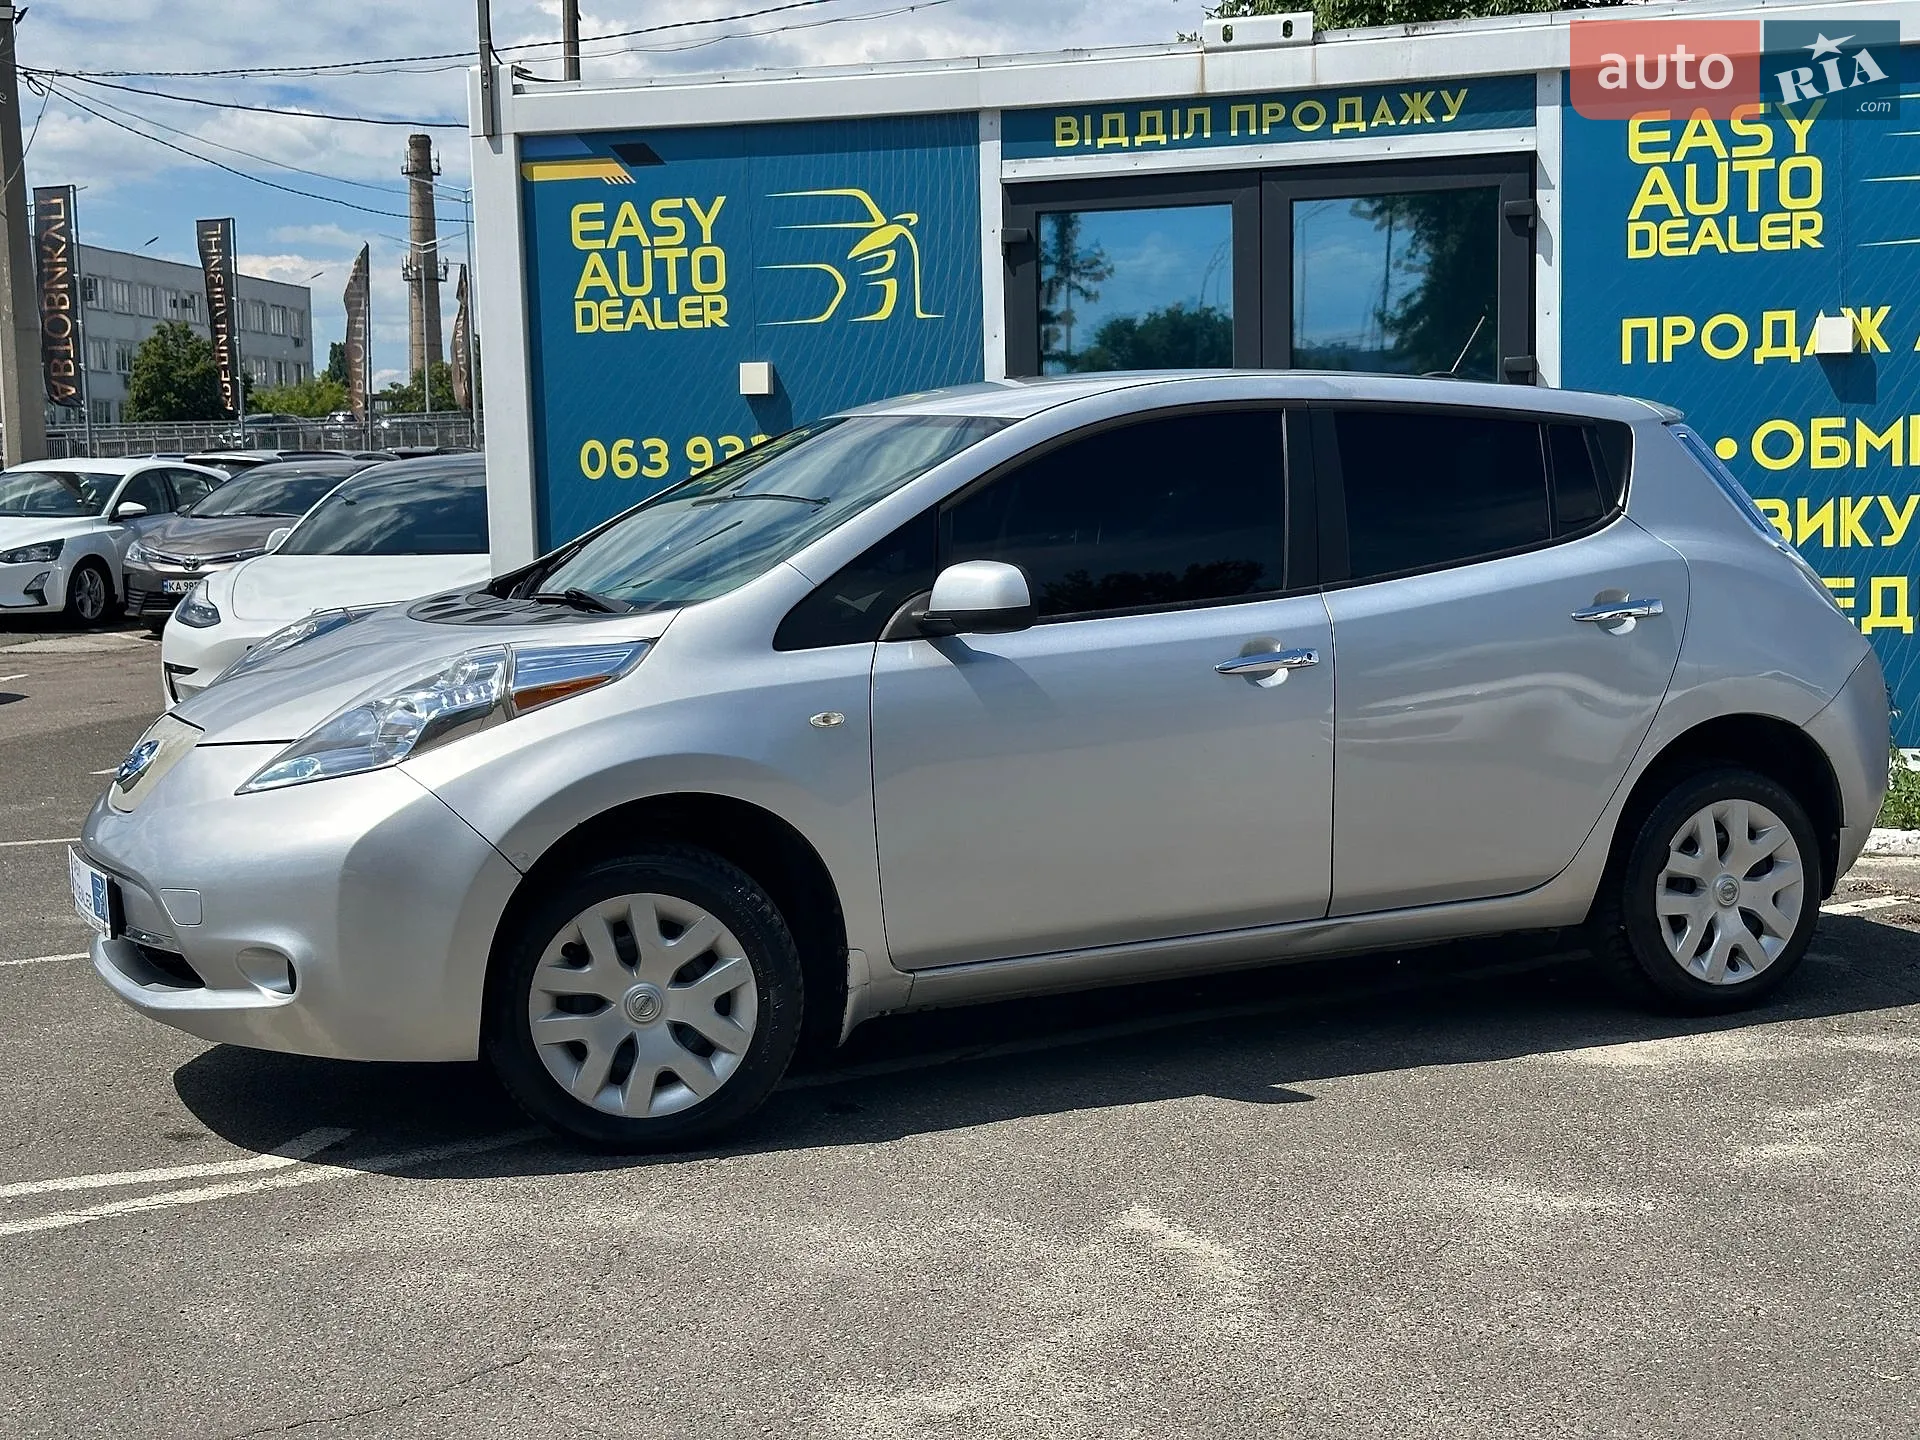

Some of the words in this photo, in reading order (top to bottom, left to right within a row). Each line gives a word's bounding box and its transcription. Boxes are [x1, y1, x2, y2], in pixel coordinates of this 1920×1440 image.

[1055, 107, 1211, 149] ВІДДІЛ
[1230, 88, 1468, 136] ПРОДАЖУ
[1628, 99, 1828, 164] EASY
[1628, 156, 1823, 220] AUTO
[571, 196, 727, 250] EASY
[1628, 211, 1825, 259] DEALER
[574, 246, 727, 299] AUTO
[575, 295, 729, 333] DEALER
[580, 438, 669, 480] 063
[685, 434, 773, 476] 93
